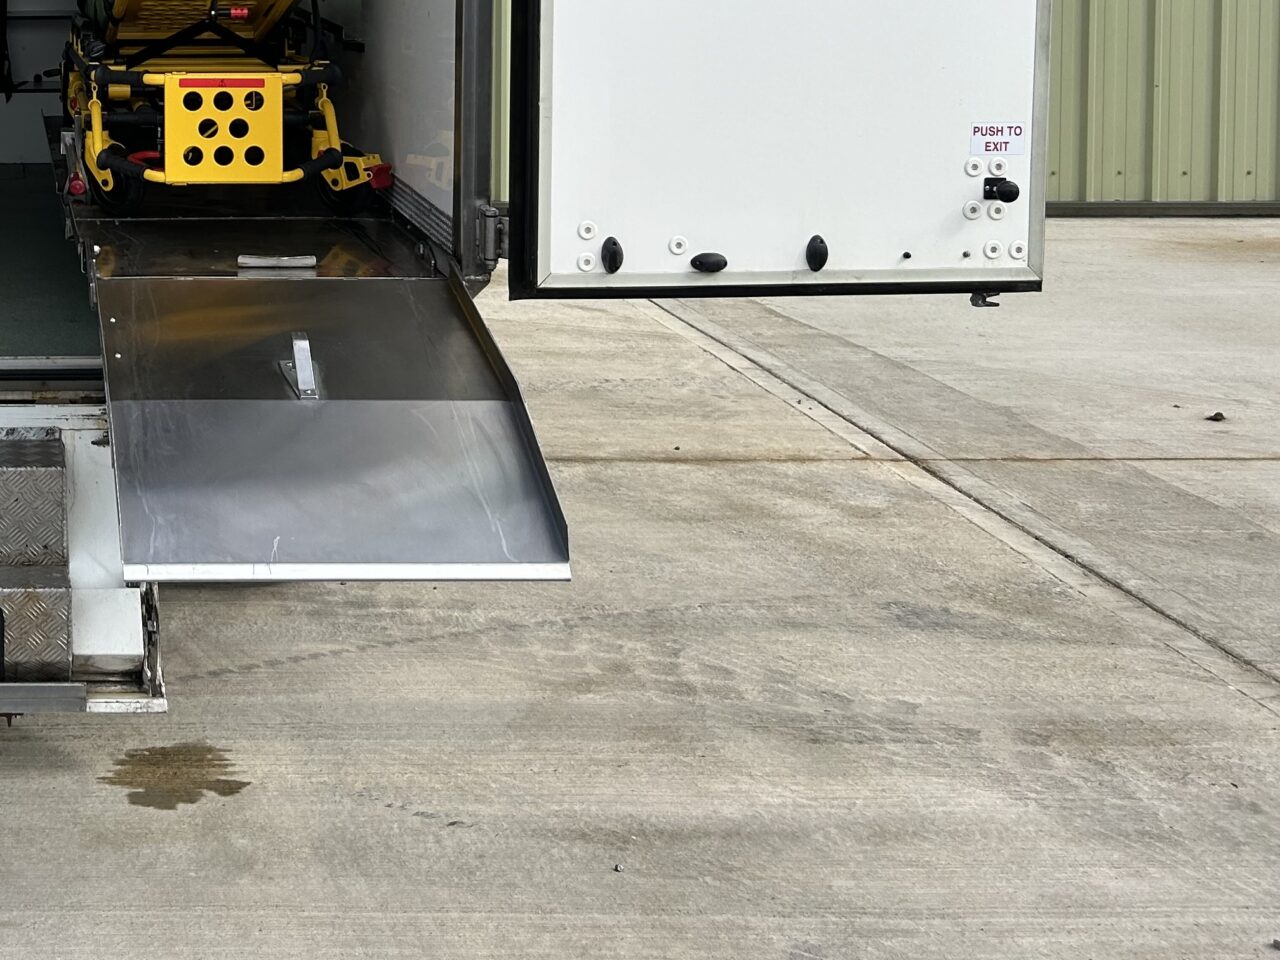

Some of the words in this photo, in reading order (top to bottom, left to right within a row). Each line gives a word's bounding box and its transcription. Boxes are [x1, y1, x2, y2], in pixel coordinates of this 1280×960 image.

[973, 126, 1004, 136] PUSH
[1007, 126, 1023, 136] TO
[984, 141, 1010, 152] EXIT
